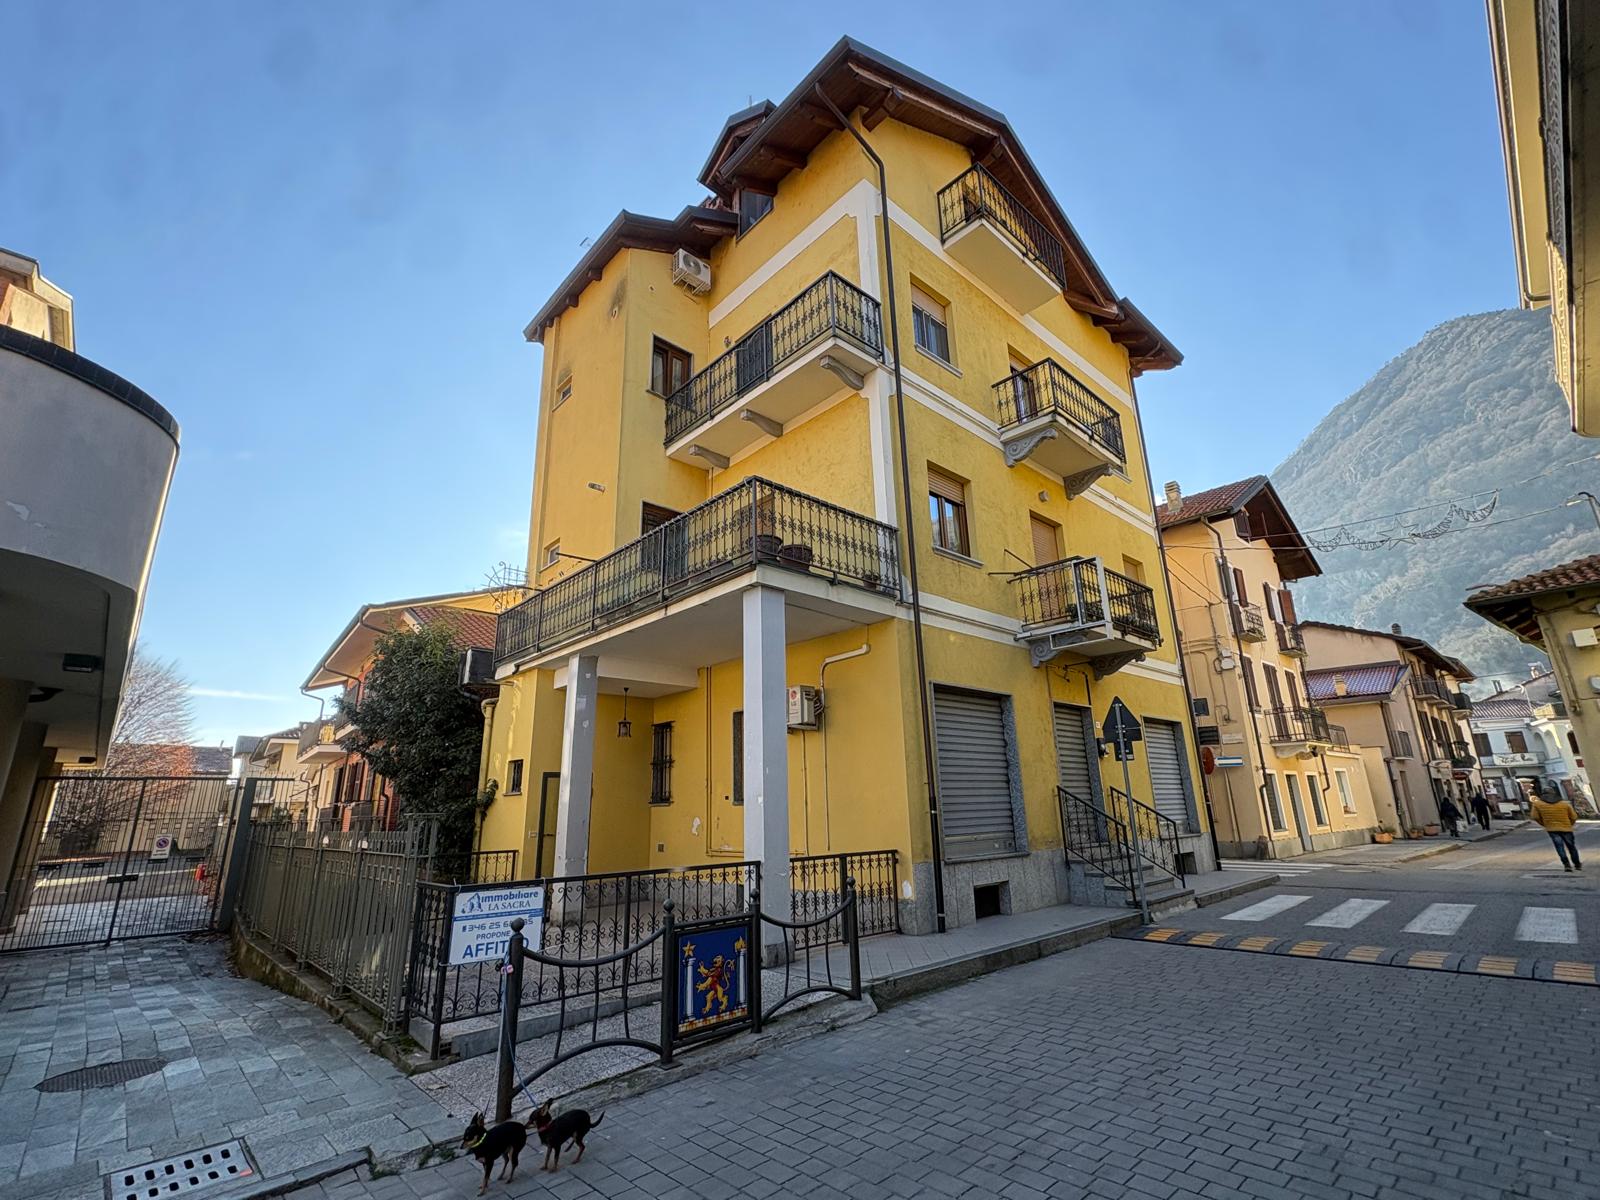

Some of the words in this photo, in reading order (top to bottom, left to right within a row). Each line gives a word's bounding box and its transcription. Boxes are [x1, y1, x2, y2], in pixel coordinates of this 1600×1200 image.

[488, 903, 499, 911] LA
[501, 900, 531, 909] SACRA
[468, 923, 486, 932] 346
[489, 921, 500, 930] 25
[476, 930, 511, 940] PROPONE
[462, 937, 529, 959] AFFIT
